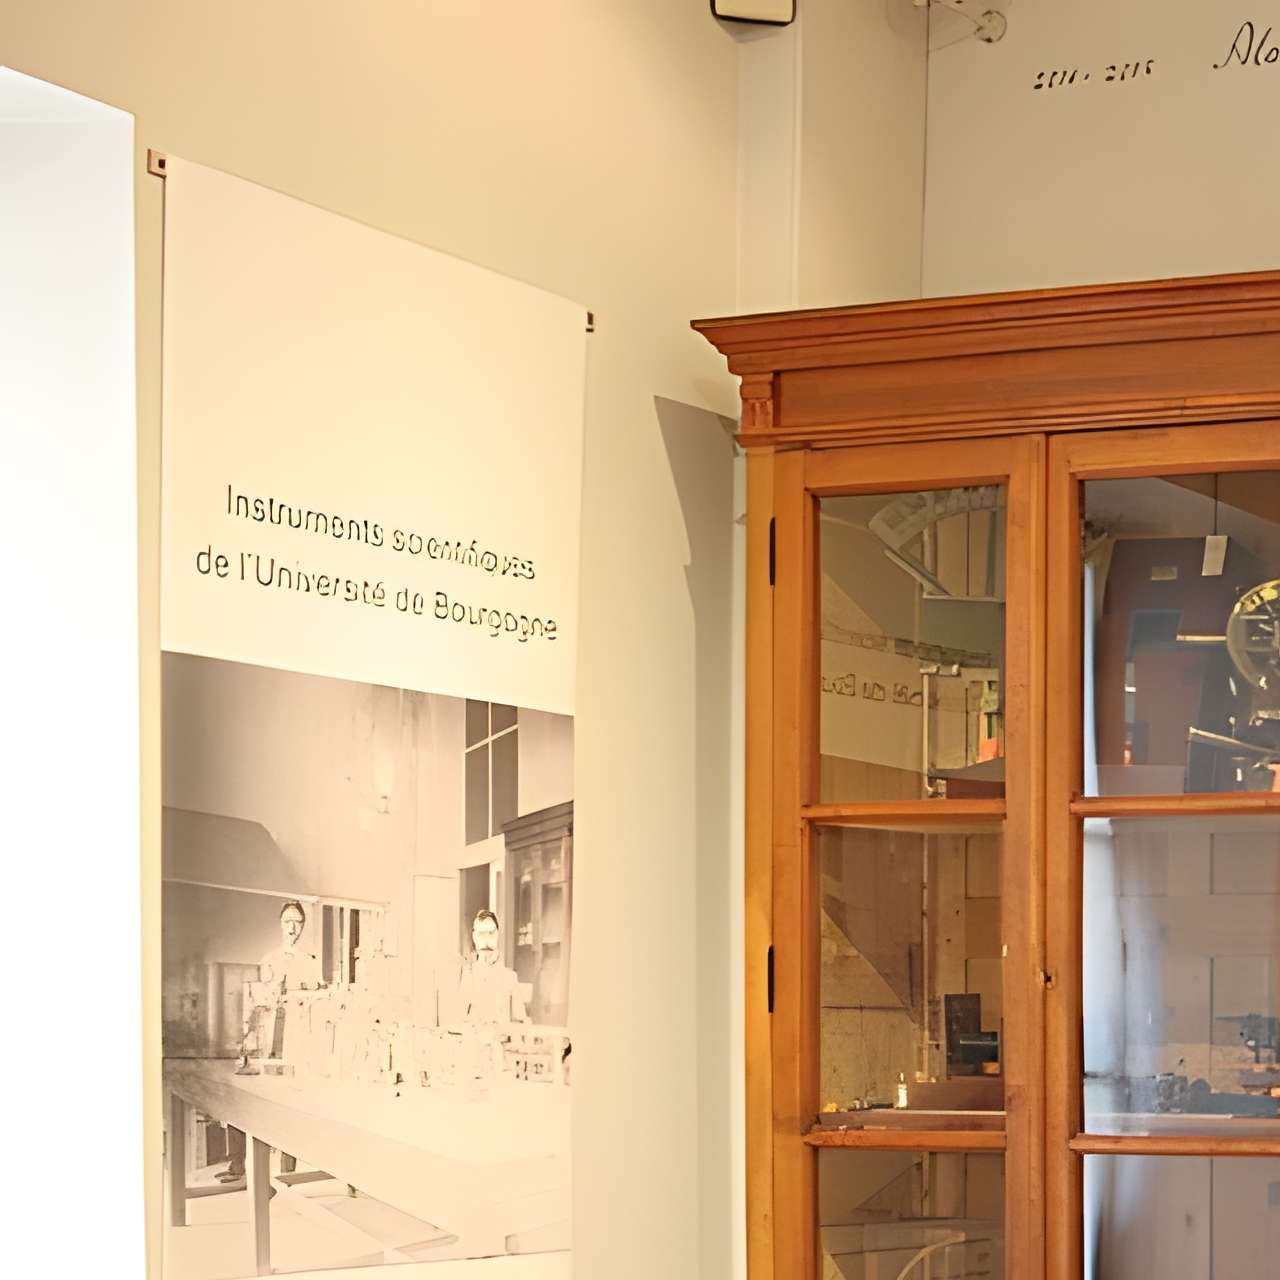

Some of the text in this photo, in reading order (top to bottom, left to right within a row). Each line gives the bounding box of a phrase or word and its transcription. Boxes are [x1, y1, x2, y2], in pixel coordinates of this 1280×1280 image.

[227, 484, 384, 547] Instruments
[196, 544, 229, 578] de
[396, 587, 424, 615] de
[434, 591, 557, 642] Bourgogne
